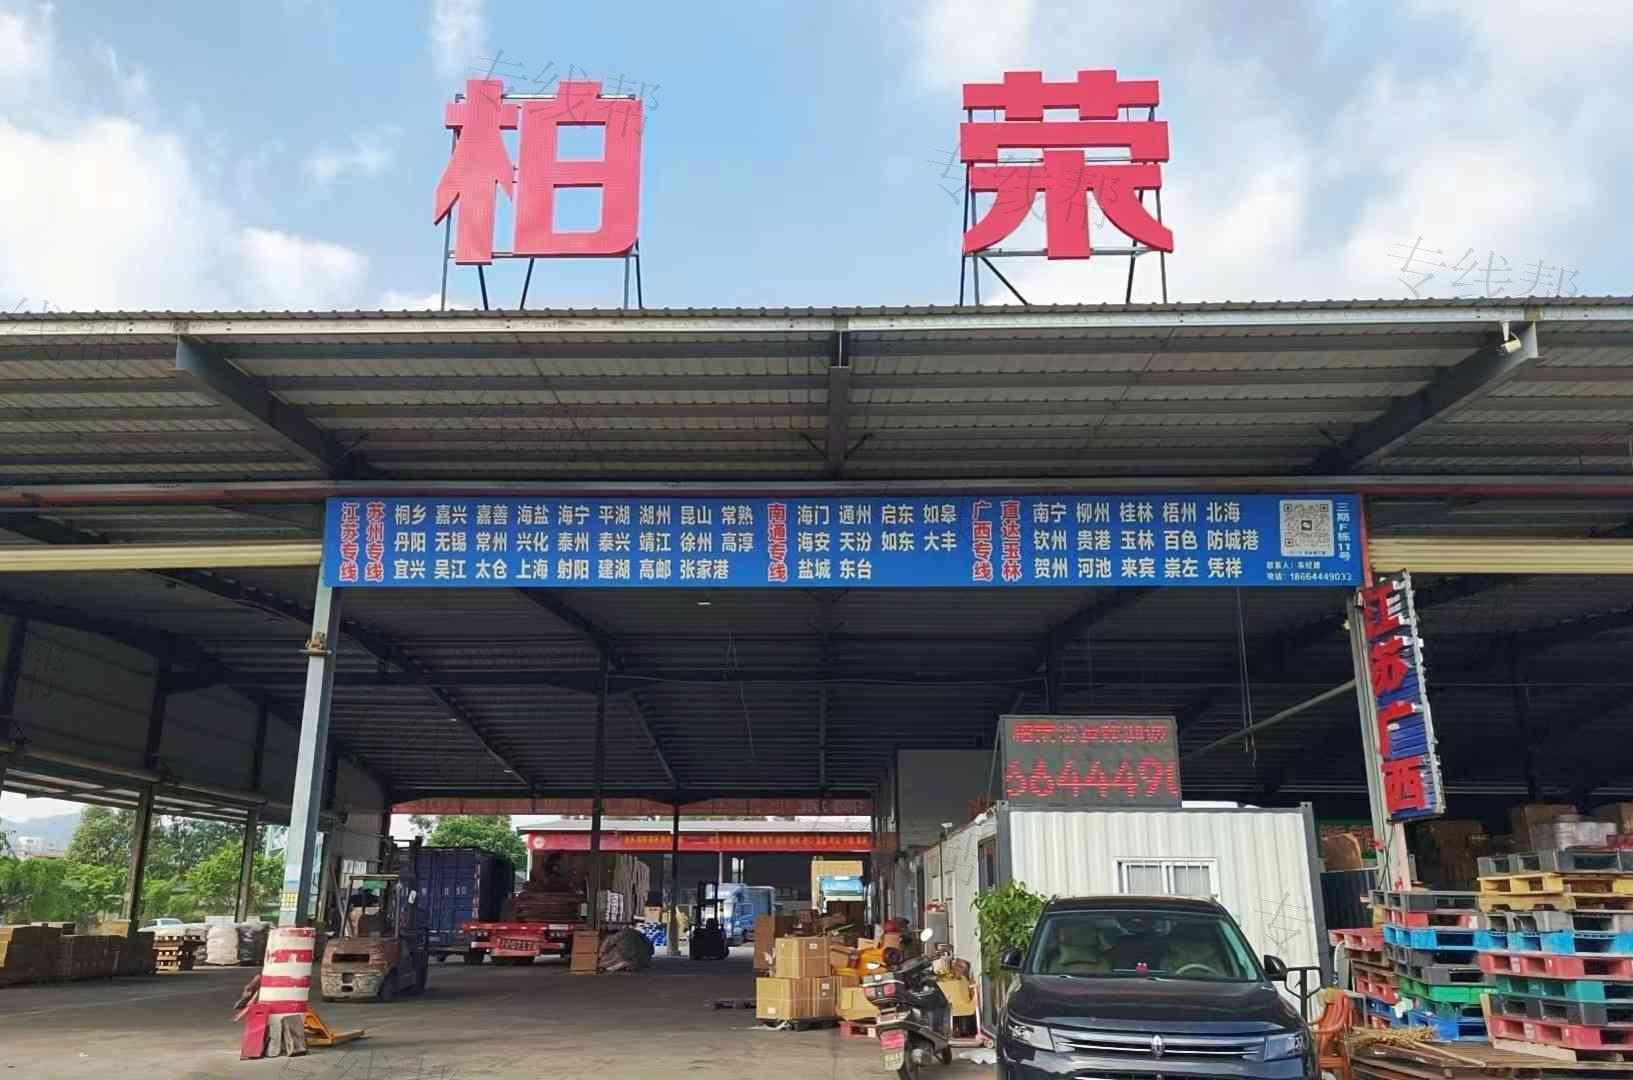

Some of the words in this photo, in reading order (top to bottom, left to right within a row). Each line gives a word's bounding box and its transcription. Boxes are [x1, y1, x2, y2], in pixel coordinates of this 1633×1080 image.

[433, 79, 643, 265] 柏
[960, 70, 1174, 260] 荣
[396, 505, 425, 524] 桐乡
[437, 506, 466, 524] 嘉兴
[477, 506, 507, 524] 嘉善
[518, 505, 548, 524] 海盐
[559, 506, 589, 524] 海宁
[600, 506, 629, 524] 平湖
[640, 506, 670, 524] 湖州
[682, 506, 711, 524] 昆山
[722, 506, 752, 524] 常熟
[798, 506, 829, 524] 海门
[840, 506, 870, 524] 通州
[882, 505, 913, 524] 启东
[924, 505, 955, 523] 如皋
[1034, 503, 1066, 522] 南宁
[1077, 504, 1109, 522] 柳州
[1120, 503, 1152, 522] 桂林
[1164, 503, 1195, 522] 梧州
[1207, 503, 1239, 522] 北海
[339, 502, 359, 582] 江苏专线
[364, 502, 386, 582] 苏州专线
[395, 532, 425, 552] 丹阳
[436, 532, 466, 551] 无锡
[476, 532, 506, 551] 常州
[517, 532, 548, 551] 兴化
[558, 533, 588, 552] 泰州
[599, 532, 630, 552] 泰兴
[640, 532, 671, 552] 靖江
[681, 533, 711, 552] 徐州
[722, 532, 753, 552] 高淳
[767, 502, 788, 582] 南通专线
[798, 532, 830, 552] 海安
[882, 532, 913, 551] 如东
[925, 531, 956, 551] 大丰
[971, 499, 993, 582] 广西专线
[1000, 499, 1022, 582] 直达玉林
[1034, 531, 1066, 549] 钦州
[1078, 530, 1110, 550] 贵港
[1122, 530, 1154, 550] 玉林
[1164, 530, 1197, 549] 百色
[1208, 530, 1258, 550] 防城港
[394, 559, 425, 578] 宜兴
[435, 560, 466, 579] 吴江
[476, 559, 507, 578] 太仓
[517, 559, 548, 579] 上海
[558, 559, 588, 579] 射阳
[599, 559, 630, 579] 建湖
[640, 559, 671, 579] 高邮
[681, 559, 728, 579] 张家港
[798, 559, 830, 578] 盐城
[840, 559, 871, 578] 东台
[1035, 558, 1067, 577] 贺州
[1078, 558, 1111, 577] 河池
[1122, 558, 1155, 577] 来宾
[1165, 558, 1198, 577] 崇左
[1208, 558, 1242, 577] 凭祥
